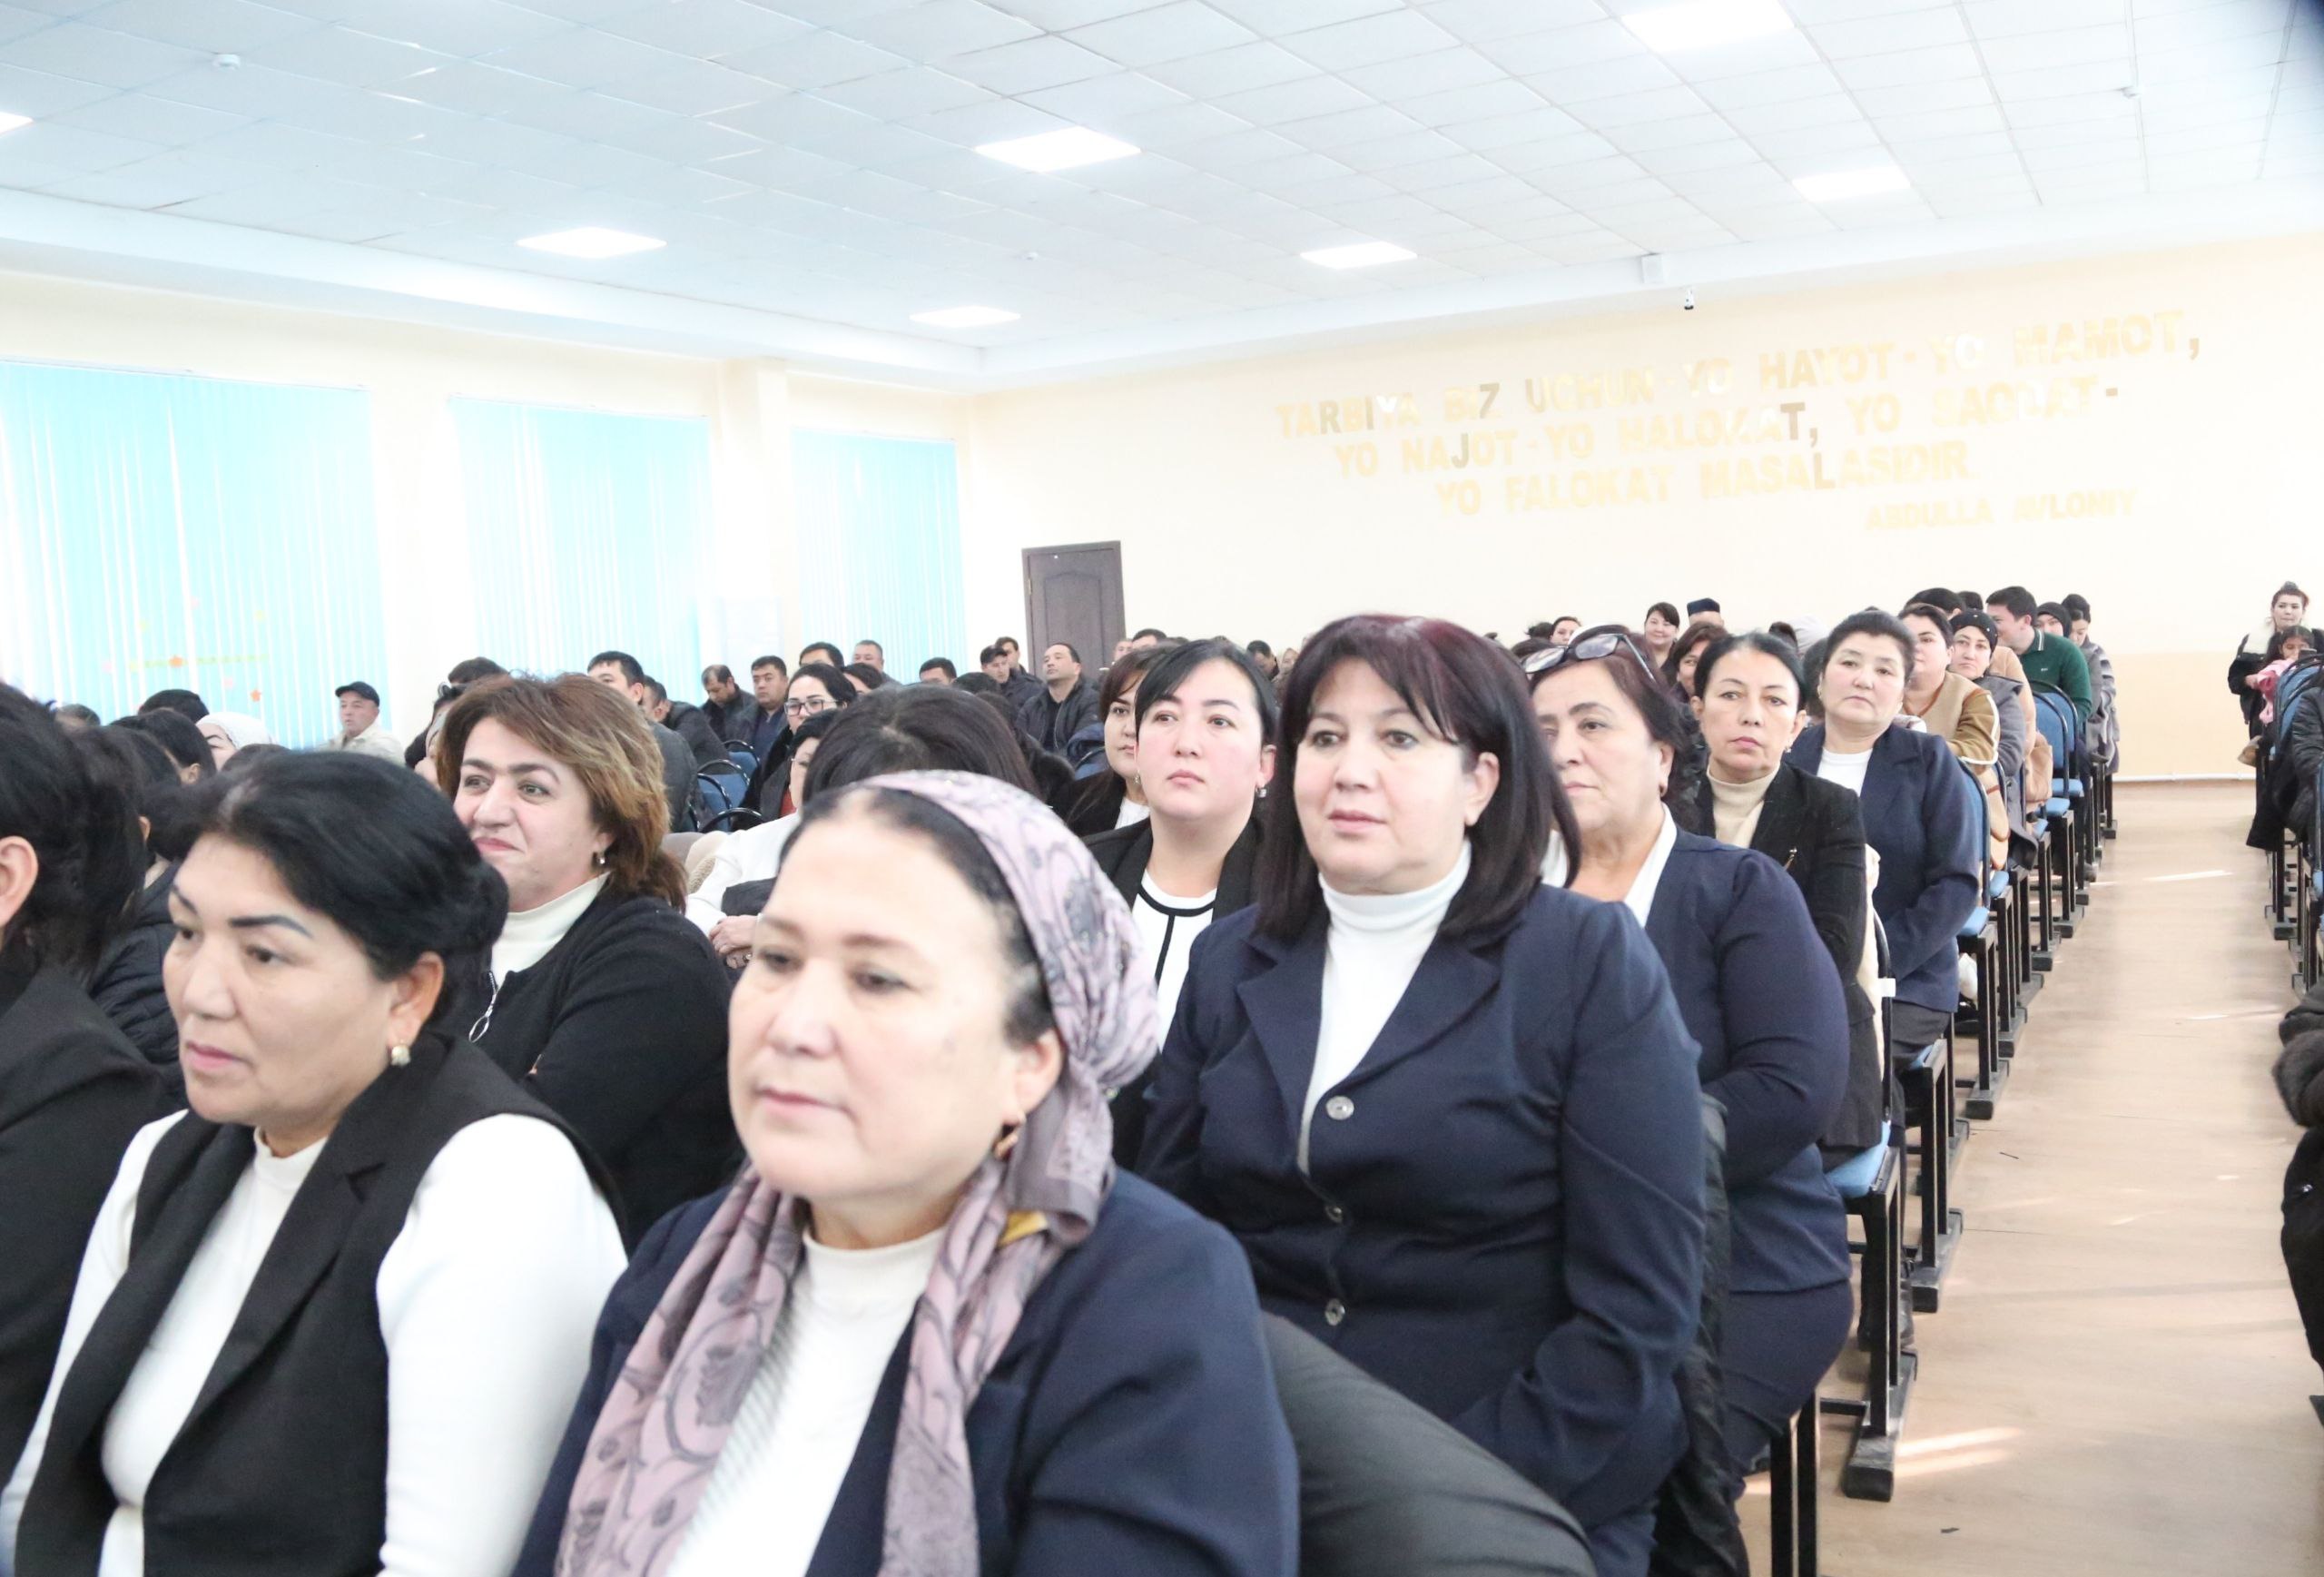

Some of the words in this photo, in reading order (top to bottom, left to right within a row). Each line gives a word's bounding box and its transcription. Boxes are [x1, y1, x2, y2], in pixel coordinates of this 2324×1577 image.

[1275, 391, 1423, 439] TARBIYA
[1443, 382, 1503, 423] BIZ
[1525, 366, 1655, 413] UCHUN
[1683, 357, 1734, 398] YO
[1758, 341, 1896, 391] HAYOT
[1927, 333, 1984, 375] YO
[1334, 440, 1379, 478] YO
[1401, 429, 1519, 474] NAJOT
[1545, 420, 1594, 461] YO
[1845, 392, 1902, 436] YO
[1435, 479, 1482, 516] YO
[1506, 465, 1675, 513] FALOKAT
[1864, 498, 1994, 530] ABDULLA
[2013, 488, 2137, 523] AVLONIY
